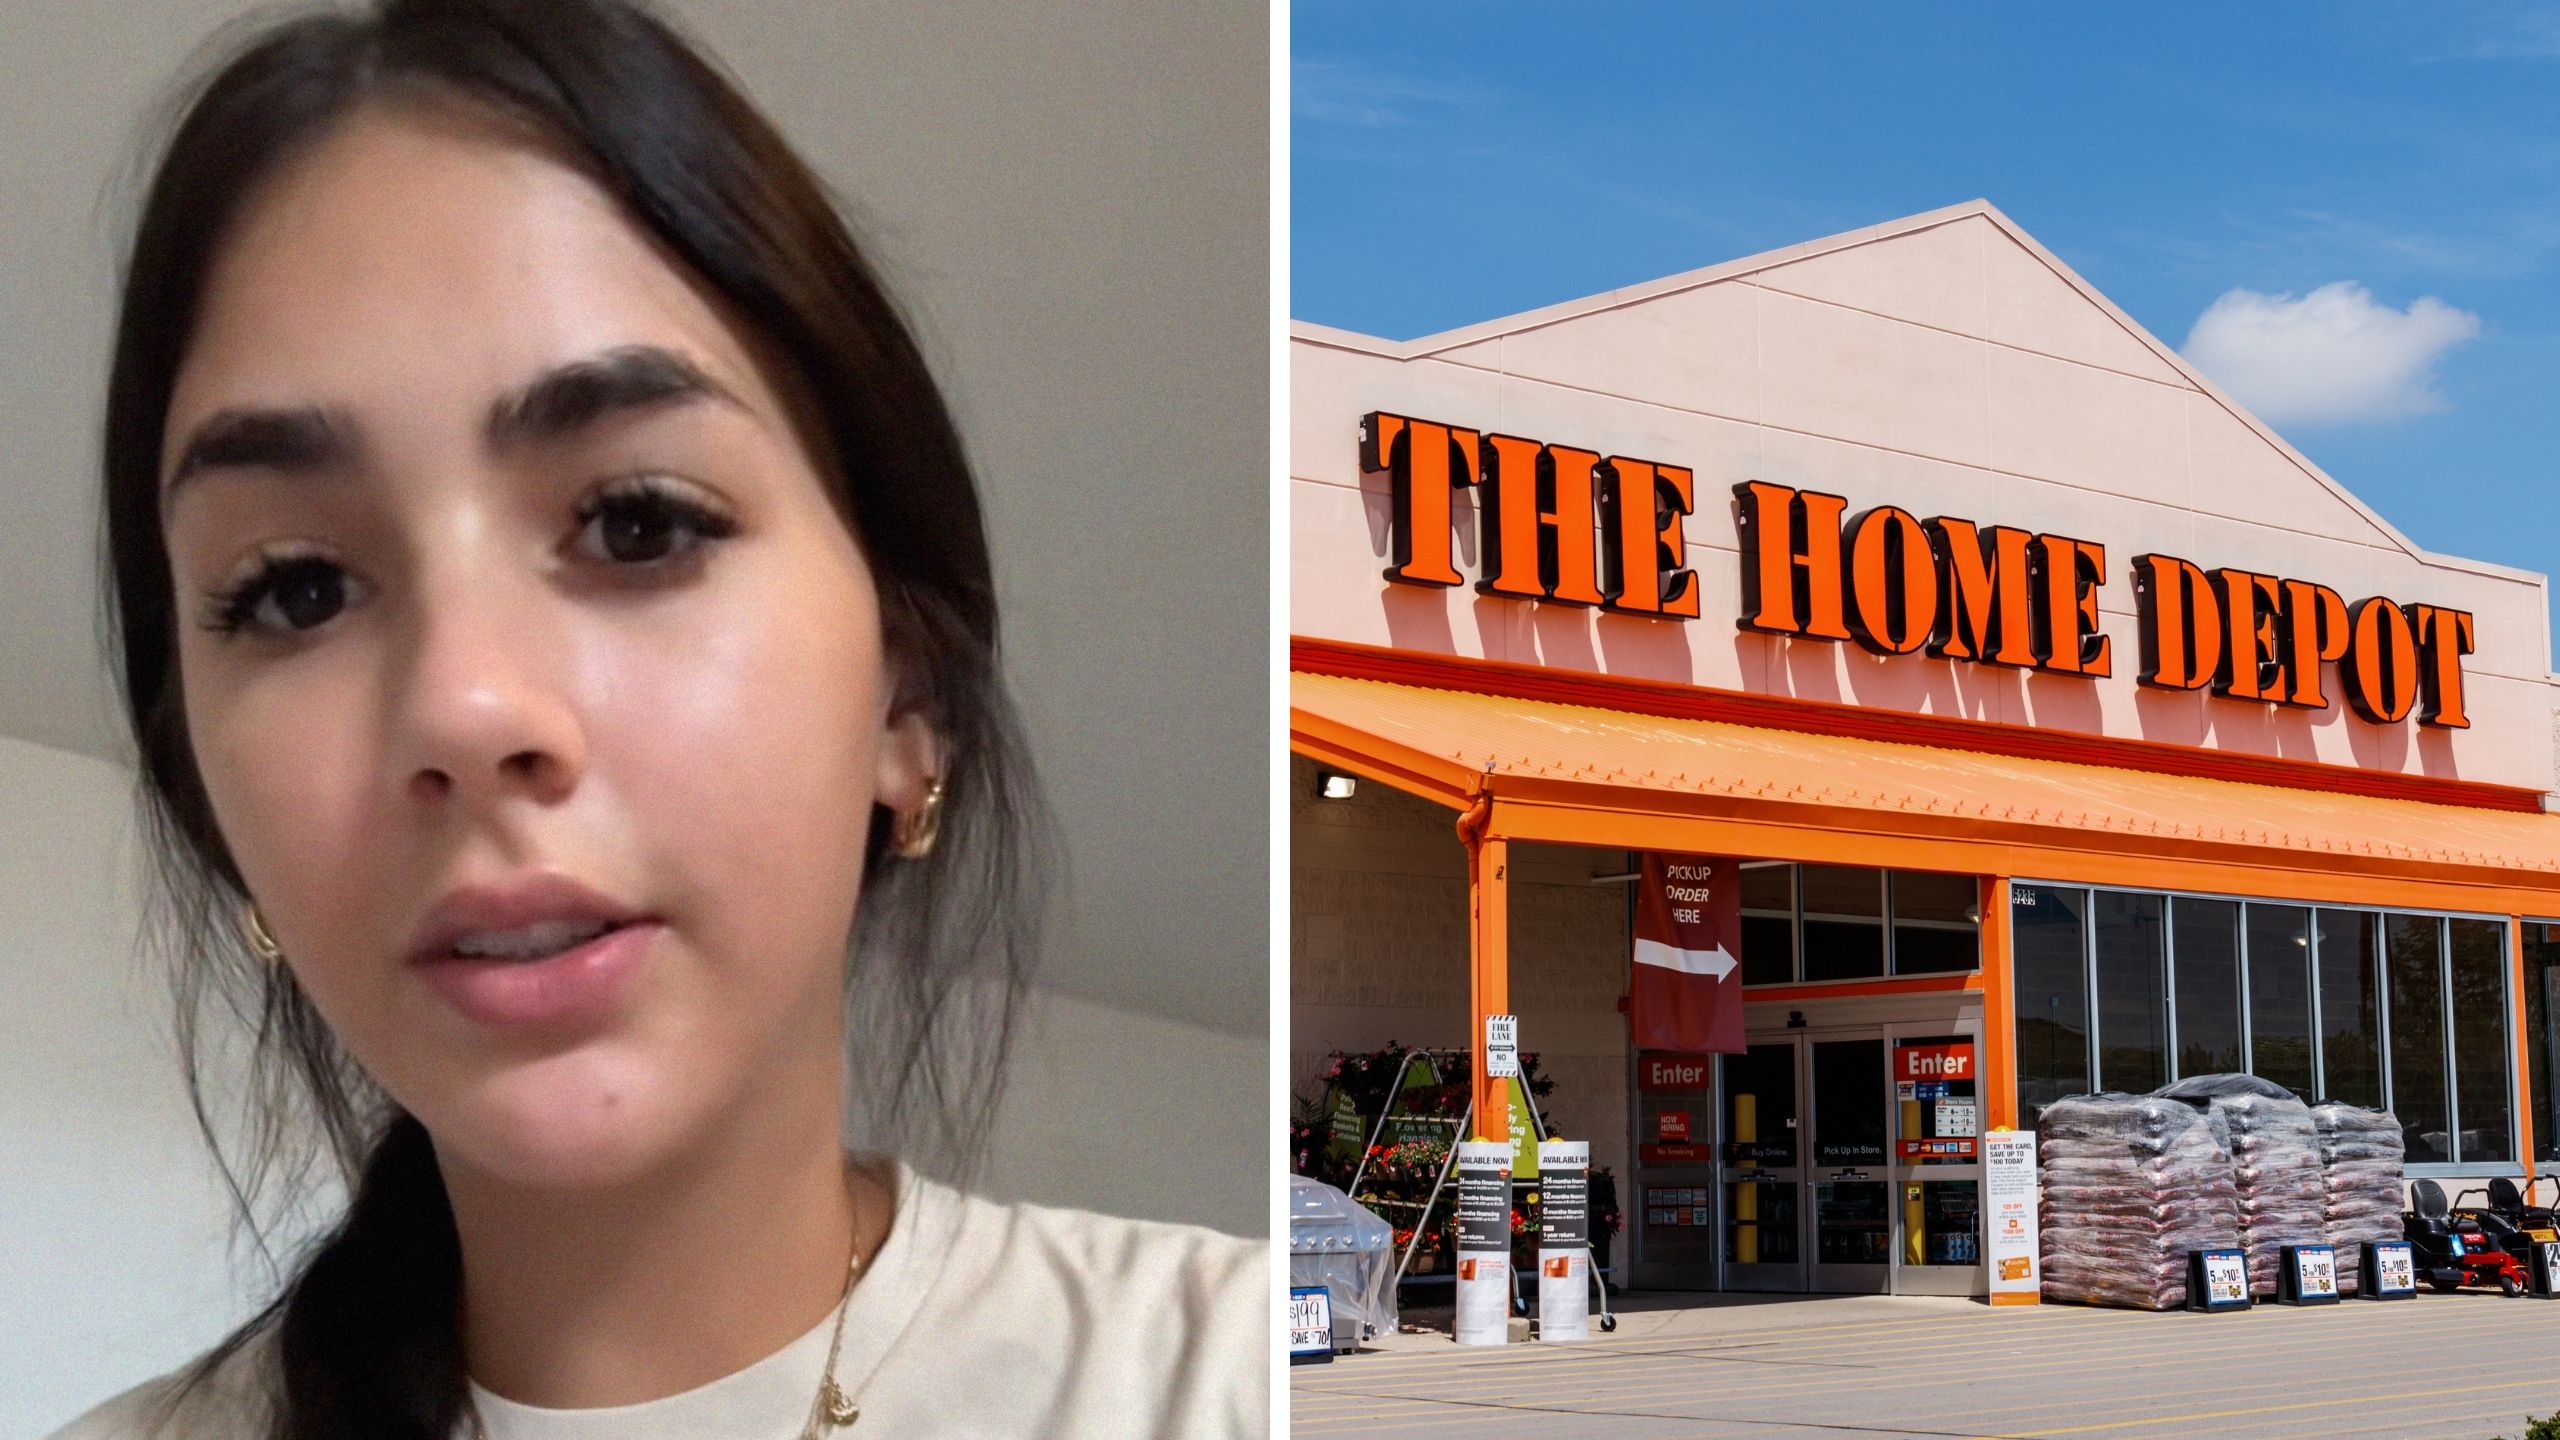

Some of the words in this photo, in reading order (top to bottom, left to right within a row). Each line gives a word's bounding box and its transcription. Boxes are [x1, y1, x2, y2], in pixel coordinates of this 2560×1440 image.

[1359, 410, 1701, 620] THE
[1731, 479, 2112, 680] HOME
[2131, 552, 2474, 730] DEPOT
[1667, 865, 1711, 880] PICKUP
[1666, 885, 1709, 902] ORDER
[1673, 907, 1700, 923] HERE
[1492, 1023, 1511, 1031] FIRE
[1491, 1032, 1511, 1041] LANE
[1909, 1051, 1967, 1075] Enter
[1652, 1063, 1703, 1085] Enter
[1661, 1124, 1685, 1132] HIRING
[1668, 1148, 1694, 1157] Smoking
[1751, 1148, 1764, 1157] Buy
[1824, 1146, 1839, 1155] Pick
[1840, 1146, 1851, 1156] Up
[1853, 1146, 1859, 1154] In
[1493, 1157, 1509, 1165] NOW
[1543, 1207, 1548, 1215] 6
[2302, 1265, 2307, 1276] 5
[2381, 1261, 2387, 1273] 5
[2210, 1270, 2216, 1282] 5
[1290, 1301, 1319, 1327] $199
[1292, 1331, 1309, 1345] SAVE
